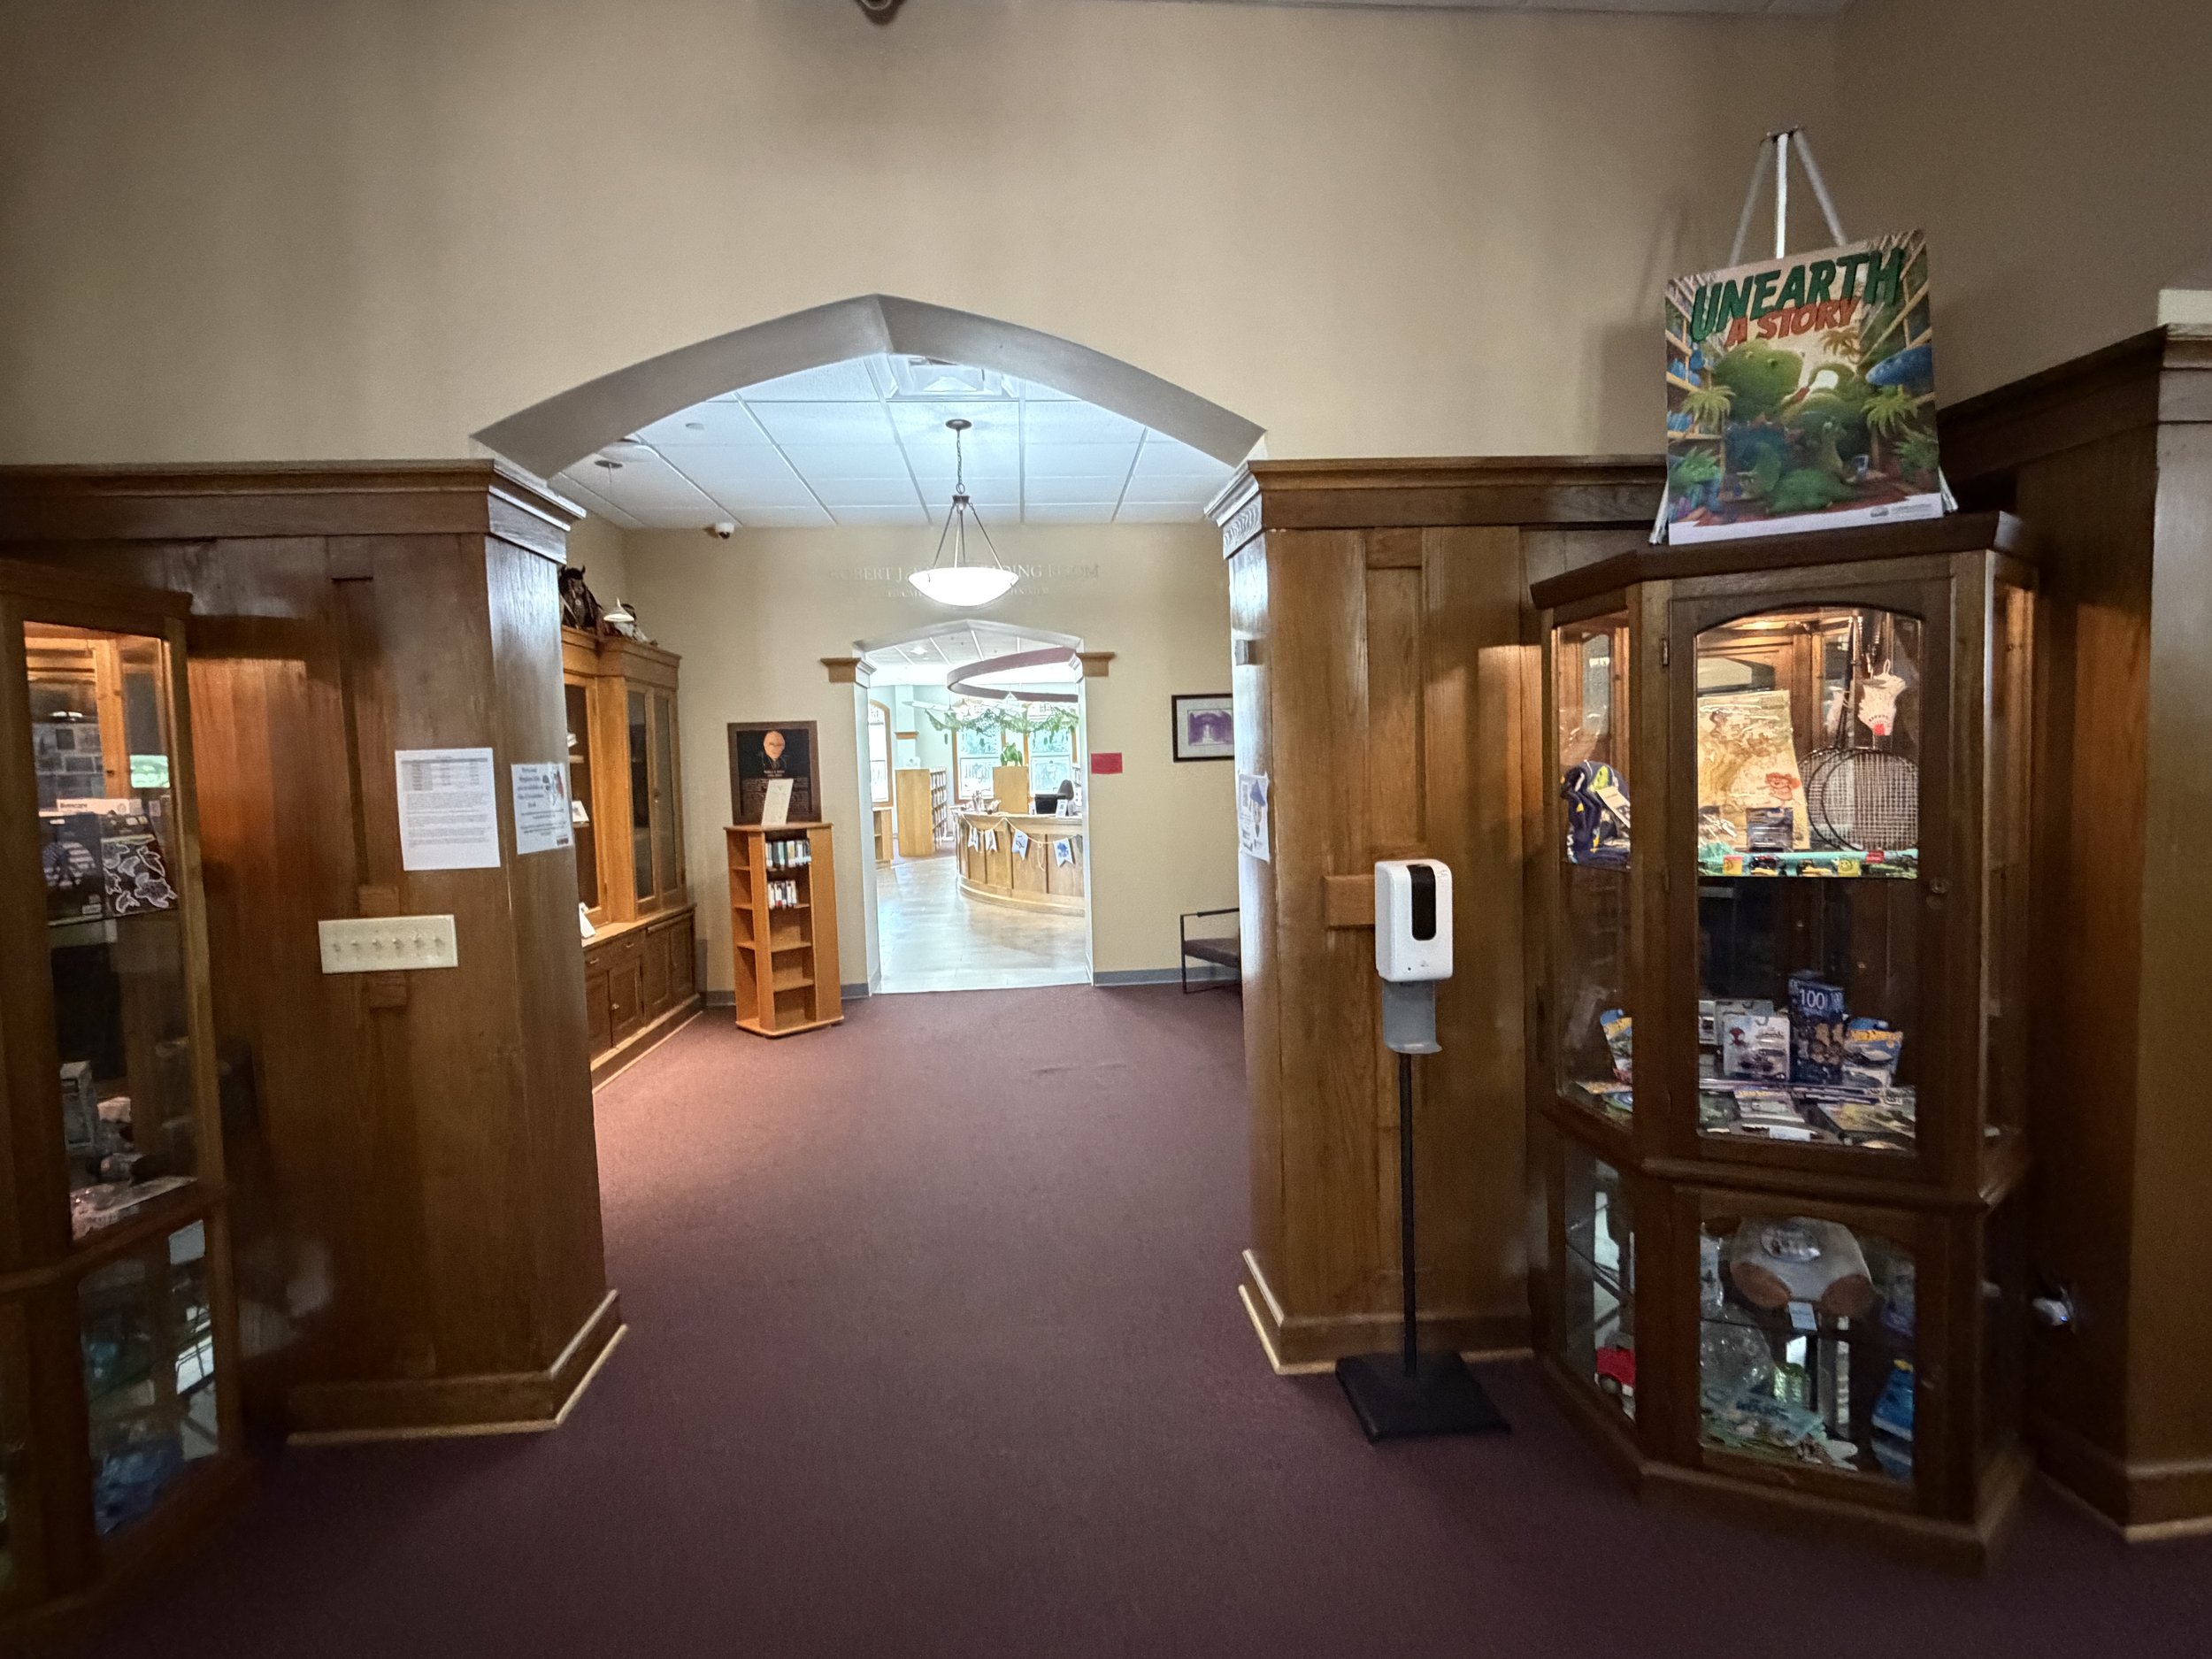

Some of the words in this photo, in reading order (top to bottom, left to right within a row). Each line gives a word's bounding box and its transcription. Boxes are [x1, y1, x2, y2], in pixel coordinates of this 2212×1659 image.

[1690, 247, 1906, 342] UNEARTH
[1725, 317, 1747, 347] A
[1755, 296, 1862, 340] STORY
[1800, 988, 1825, 1010] 100
